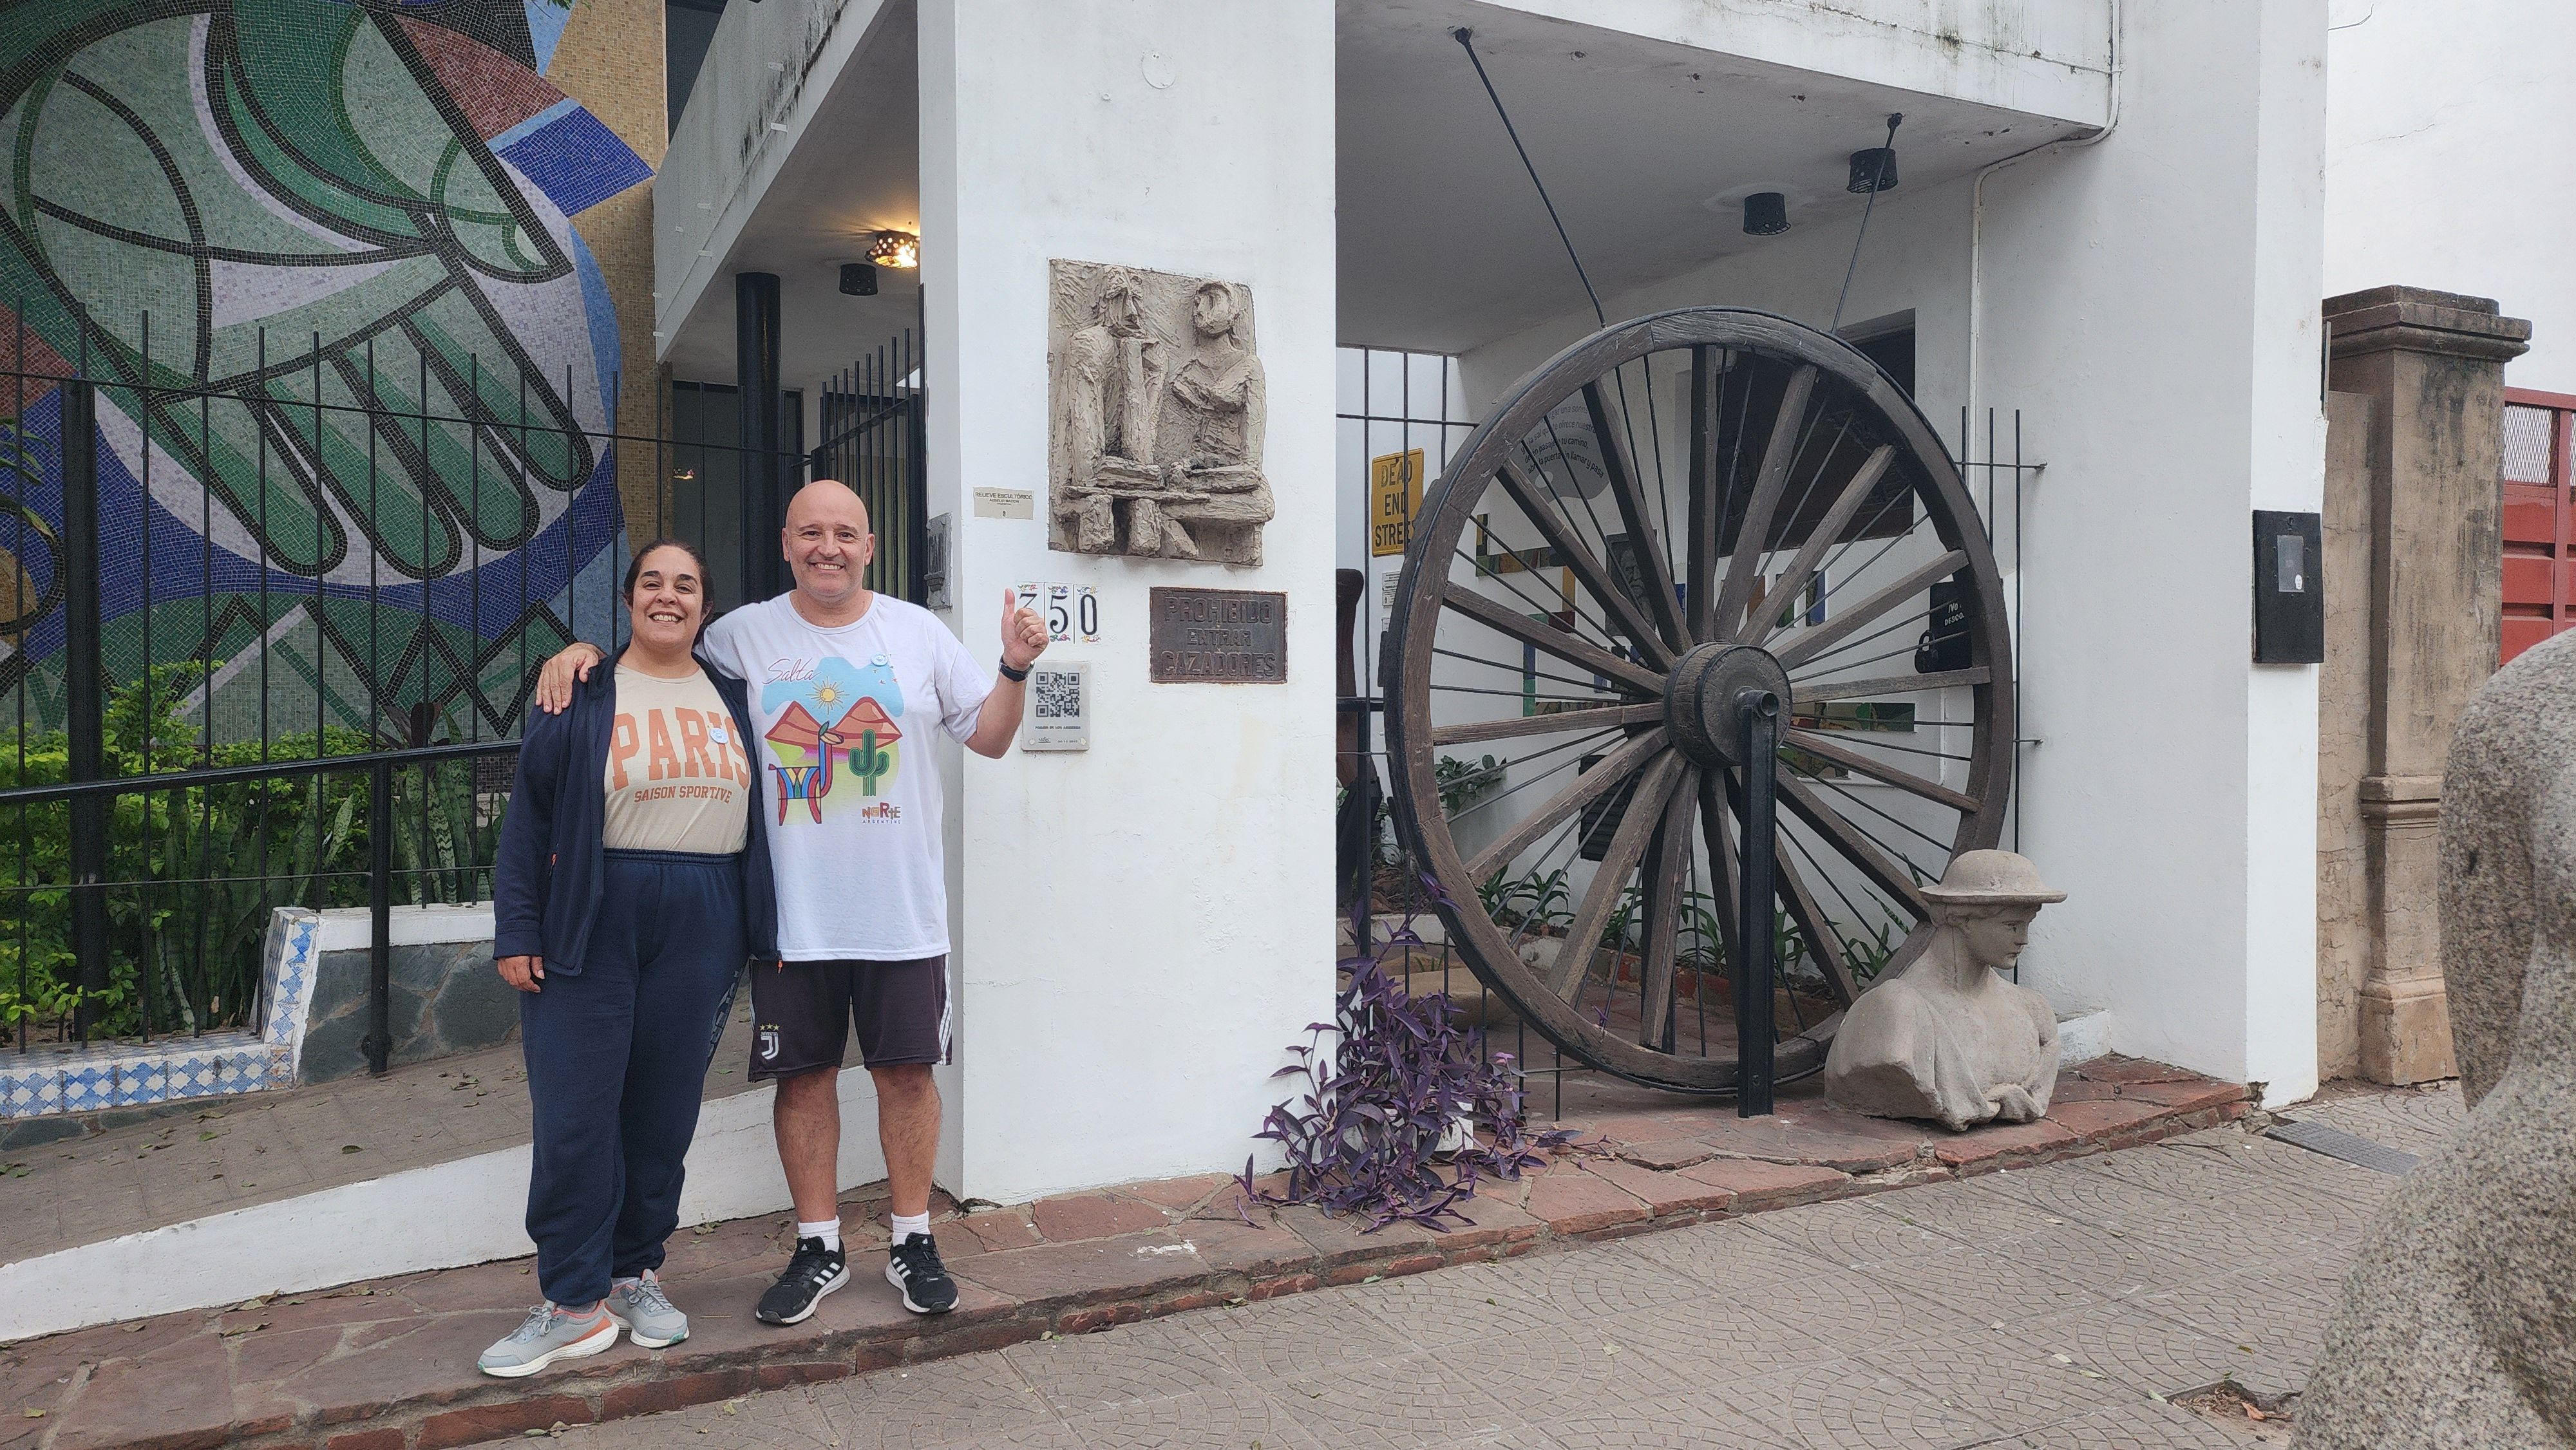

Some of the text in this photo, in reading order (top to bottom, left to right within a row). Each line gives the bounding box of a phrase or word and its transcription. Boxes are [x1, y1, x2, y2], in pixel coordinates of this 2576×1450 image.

[1381, 460, 1413, 487] DEAD
[1544, 452, 1560, 465] puerta
[1590, 463, 1604, 478] pasa
[1375, 520, 1414, 547] STREE
[1164, 596, 1273, 624] PROHIBIDO
[1186, 627, 1251, 646] ENTRAR
[762, 658, 822, 684] Salta
[1161, 650, 1276, 677] CAZADORES
[612, 706, 750, 791] PARIS
[634, 786, 732, 804] SAISON SPORTIVE
